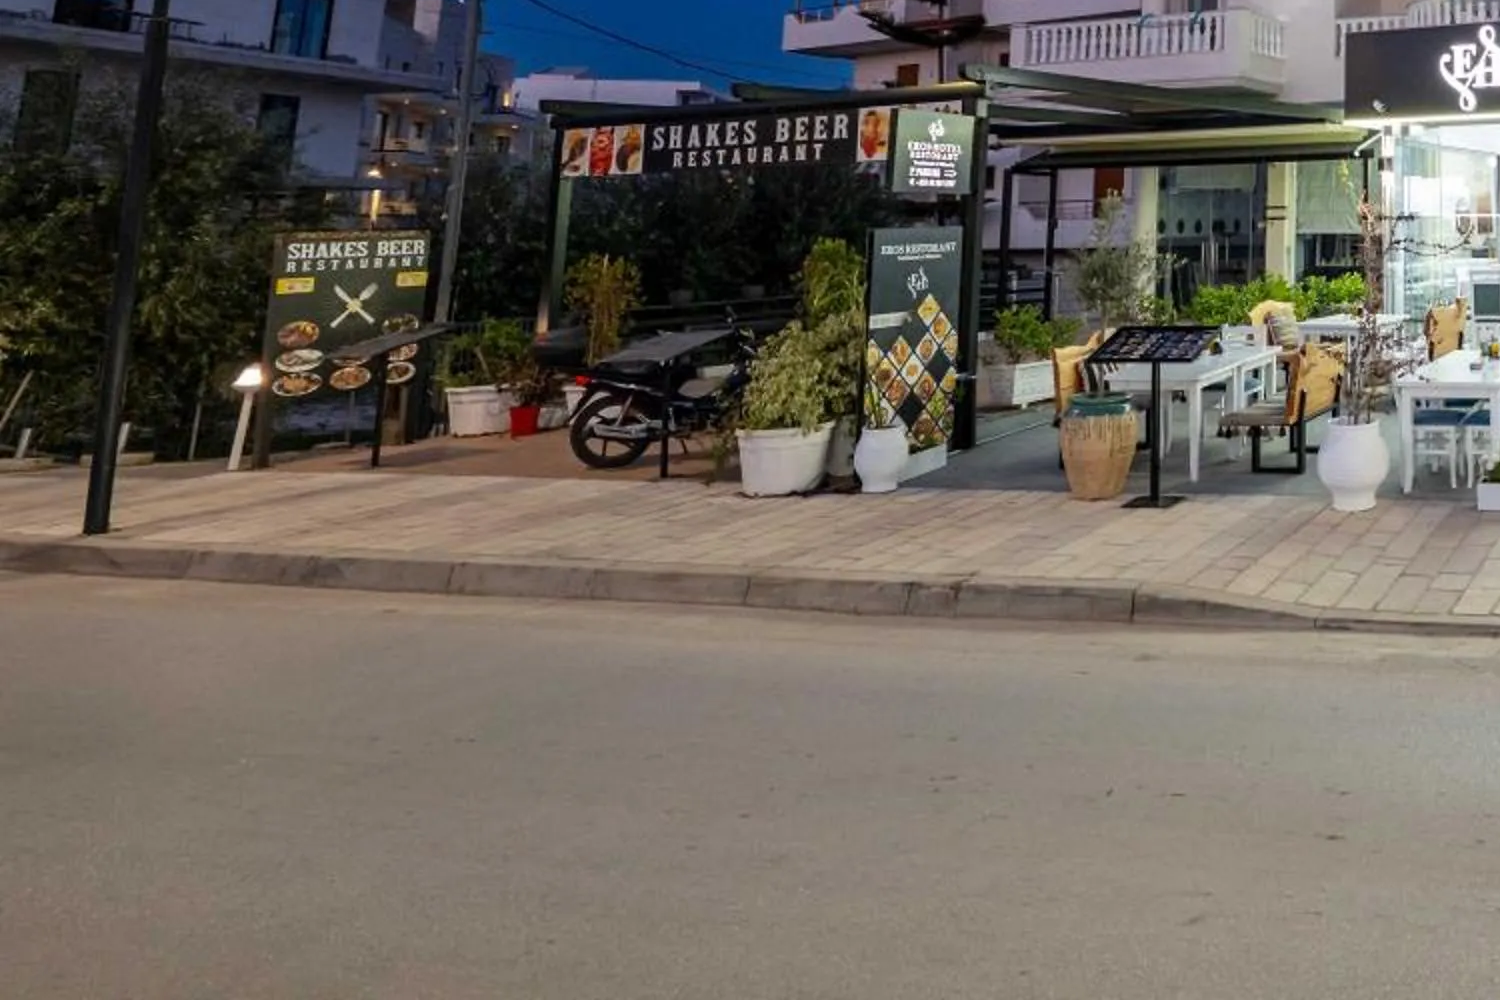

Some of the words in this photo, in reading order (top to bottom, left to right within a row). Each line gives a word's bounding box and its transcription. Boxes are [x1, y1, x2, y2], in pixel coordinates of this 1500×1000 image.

[652, 119, 757, 151] SHAKES
[775, 113, 849, 143] BEER
[672, 143, 824, 168] RESTAURANT
[287, 241, 369, 260] SHAKES
[377, 239, 426, 256] BEER
[286, 255, 427, 273] RESTAURANT
